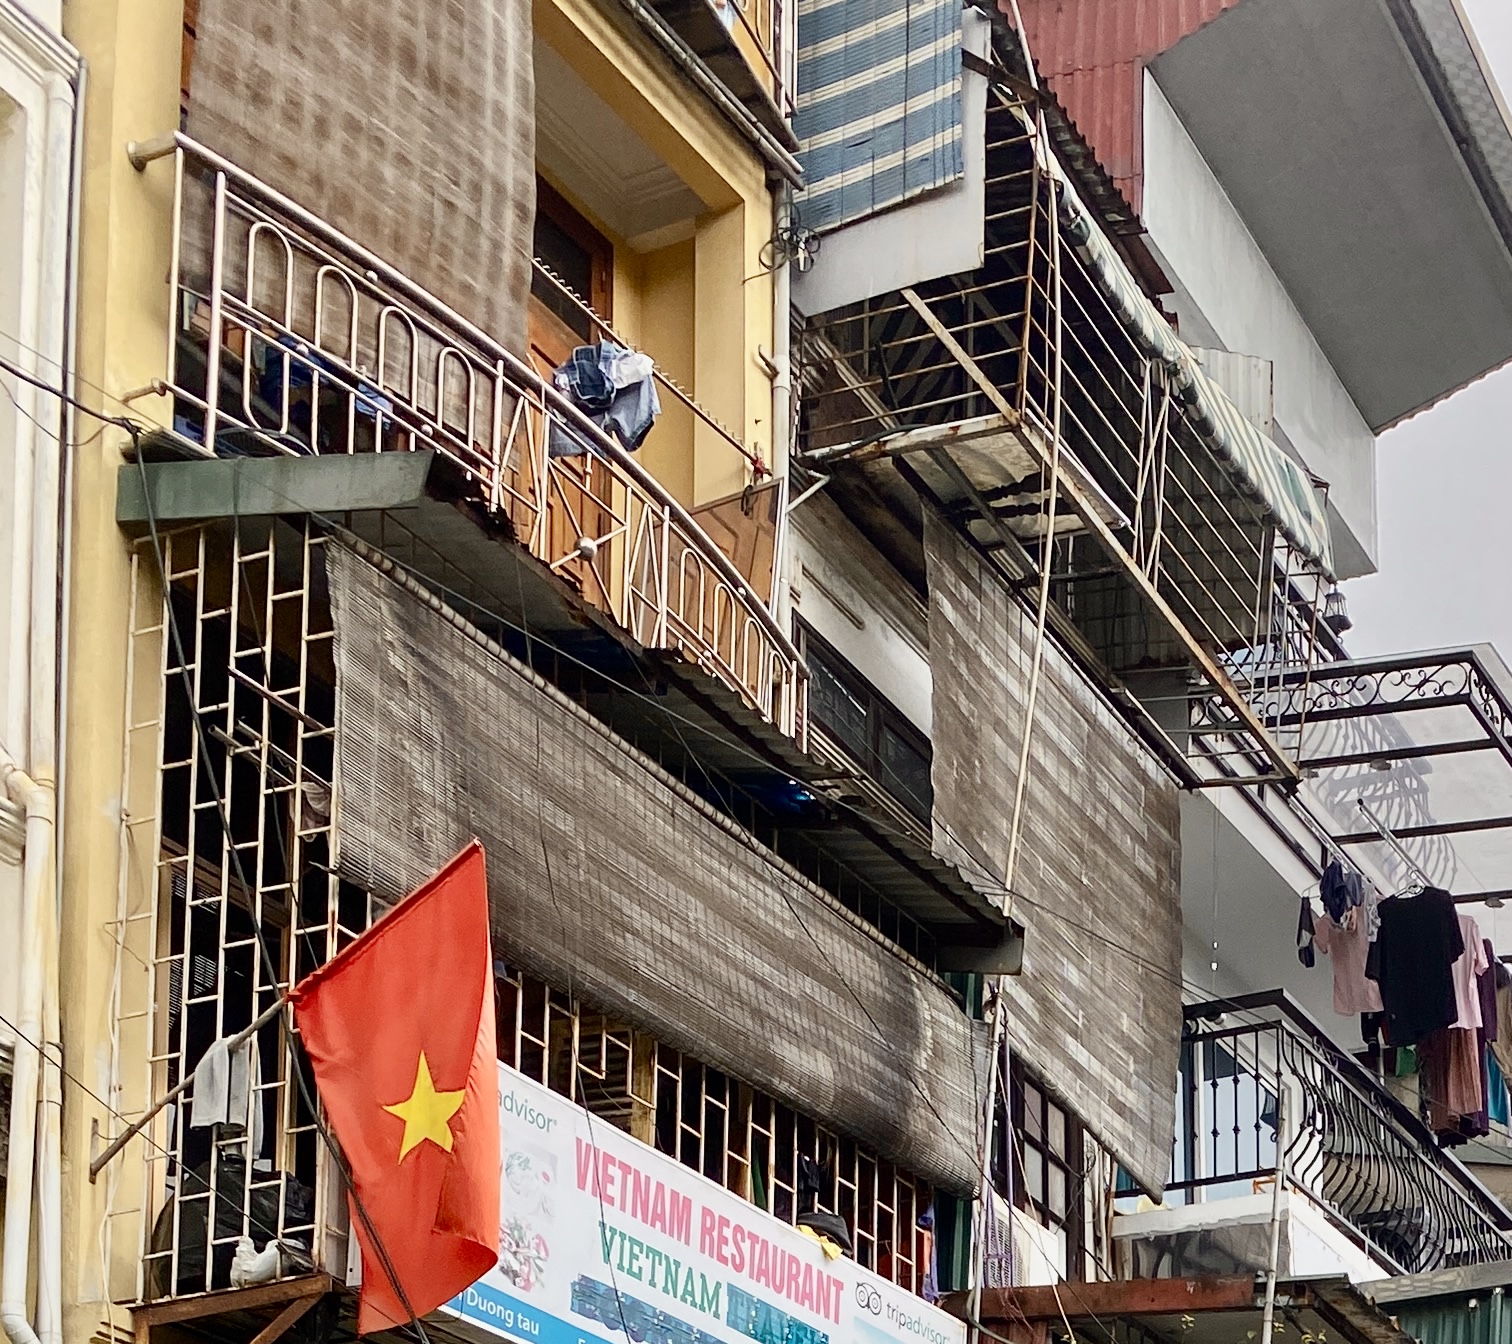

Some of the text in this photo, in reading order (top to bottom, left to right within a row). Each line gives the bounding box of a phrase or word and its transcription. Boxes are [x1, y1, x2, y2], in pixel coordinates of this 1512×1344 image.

[575, 1136, 844, 1325] VIETNAM RESTAURANT
[598, 1220, 723, 1321] VIETNAM
[467, 1288, 513, 1328] Duong
[517, 1313, 540, 1336] tau
